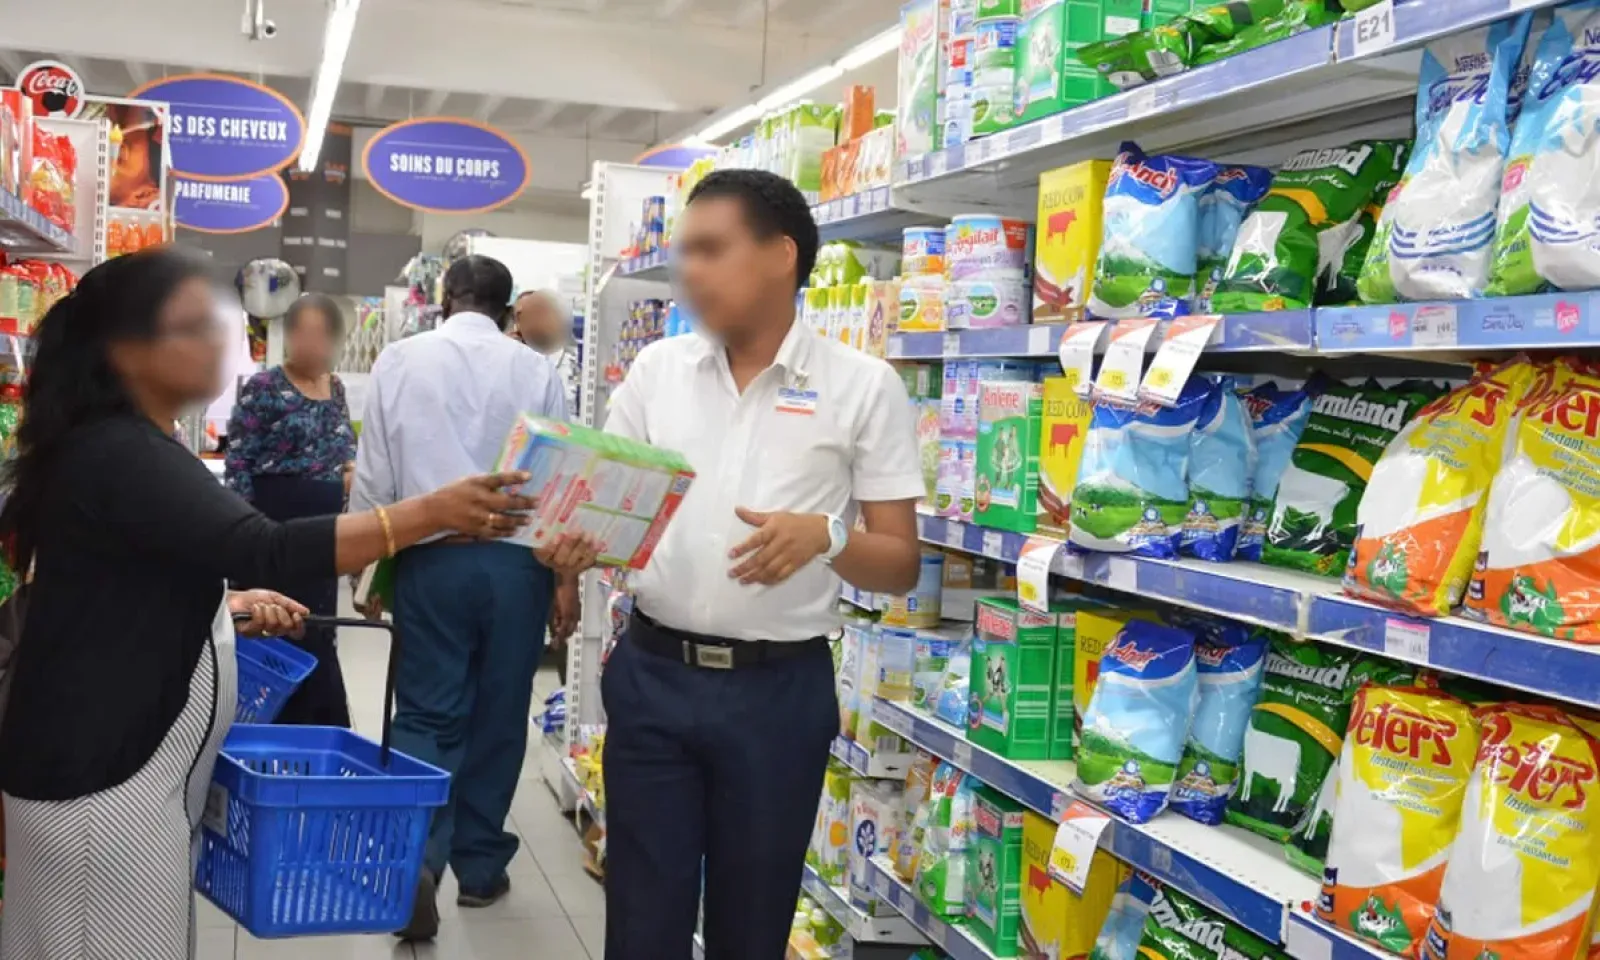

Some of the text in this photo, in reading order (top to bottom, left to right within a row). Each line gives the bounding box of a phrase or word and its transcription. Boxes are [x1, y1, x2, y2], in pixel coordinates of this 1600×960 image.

[1357, 10, 1389, 43] E21
[187, 115, 216, 137] DES
[219, 117, 287, 141] CHEVEUX
[390, 153, 431, 173] SOINS
[435, 155, 453, 174] DU
[456, 158, 500, 178] CORPS
[175, 181, 251, 203] PARFUMERIE
[984, 385, 1019, 409] Anlene
[1047, 399, 1088, 418] RED COW
[1371, 752, 1409, 773] Instant
